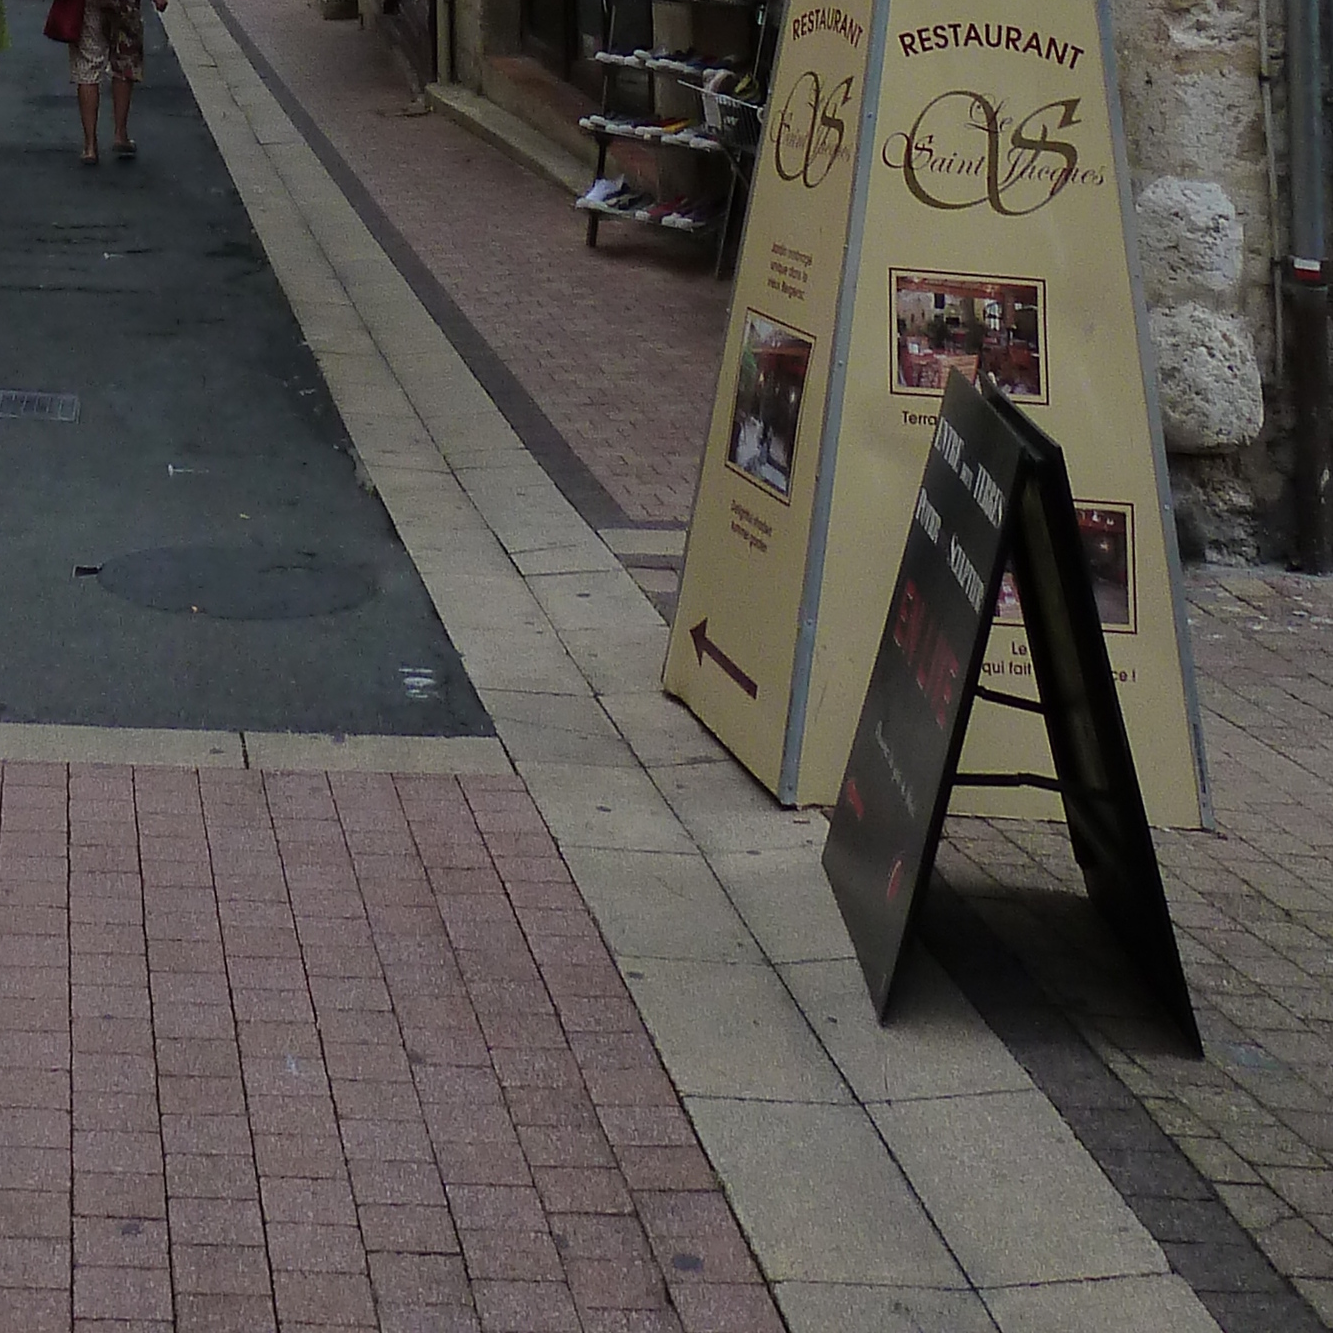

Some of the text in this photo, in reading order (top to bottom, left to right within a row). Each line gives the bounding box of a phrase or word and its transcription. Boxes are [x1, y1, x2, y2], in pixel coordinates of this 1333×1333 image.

[792, 7, 864, 49] RESTAURANT
[898, 22, 1085, 70] RESTAURANT
[882, 132, 1106, 199] Saint Jacques
[902, 410, 937, 426] Terra
[981, 660, 1004, 677] qui
[1008, 661, 1032, 676] fait
